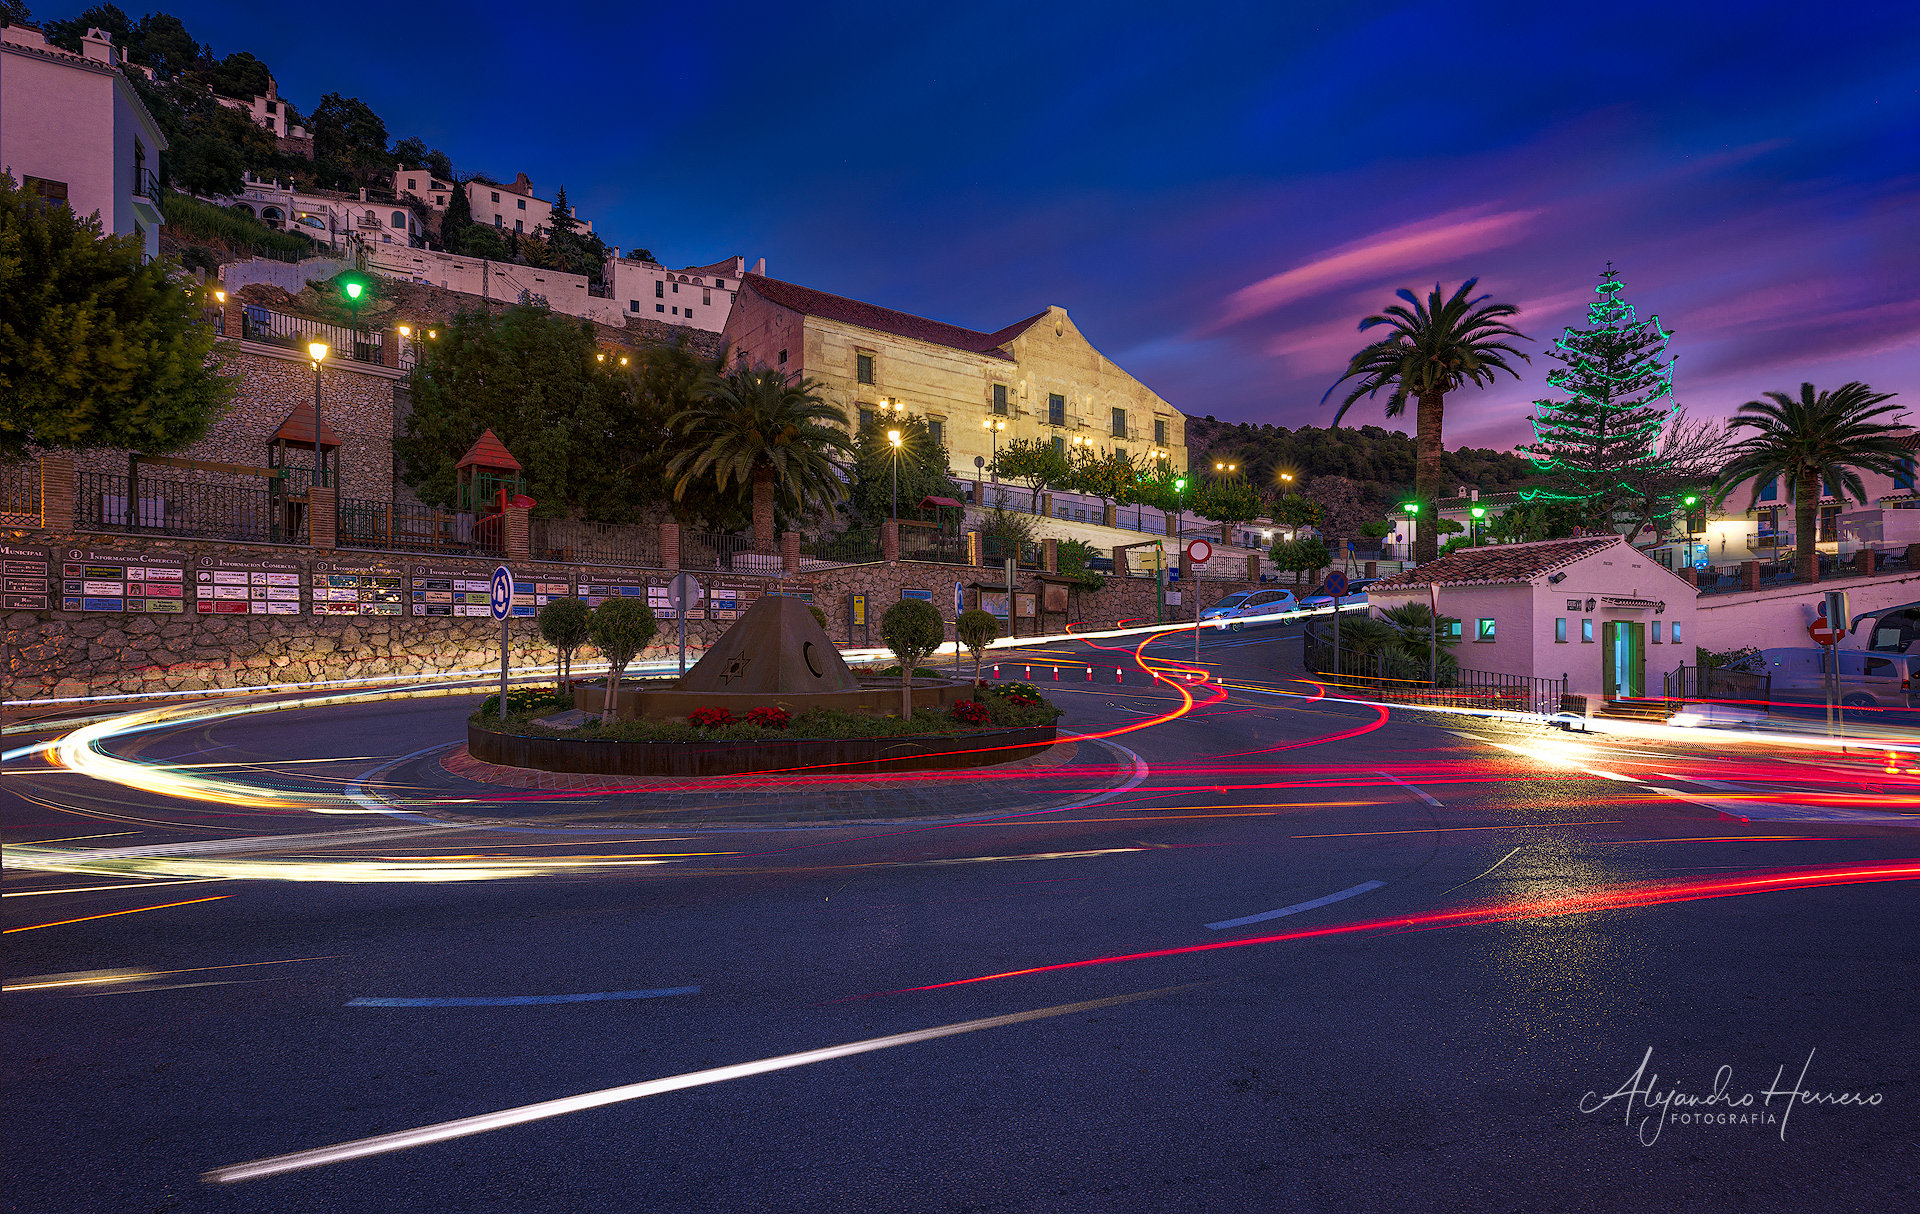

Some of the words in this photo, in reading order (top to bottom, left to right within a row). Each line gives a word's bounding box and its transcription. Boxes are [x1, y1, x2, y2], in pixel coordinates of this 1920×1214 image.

[89, 551, 139, 562] INFORMACIÓN
[139, 555, 181, 565] COMERCIAL
[219, 559, 261, 568] INFORMACIÓN
[261, 561, 298, 570] COMERCIAL
